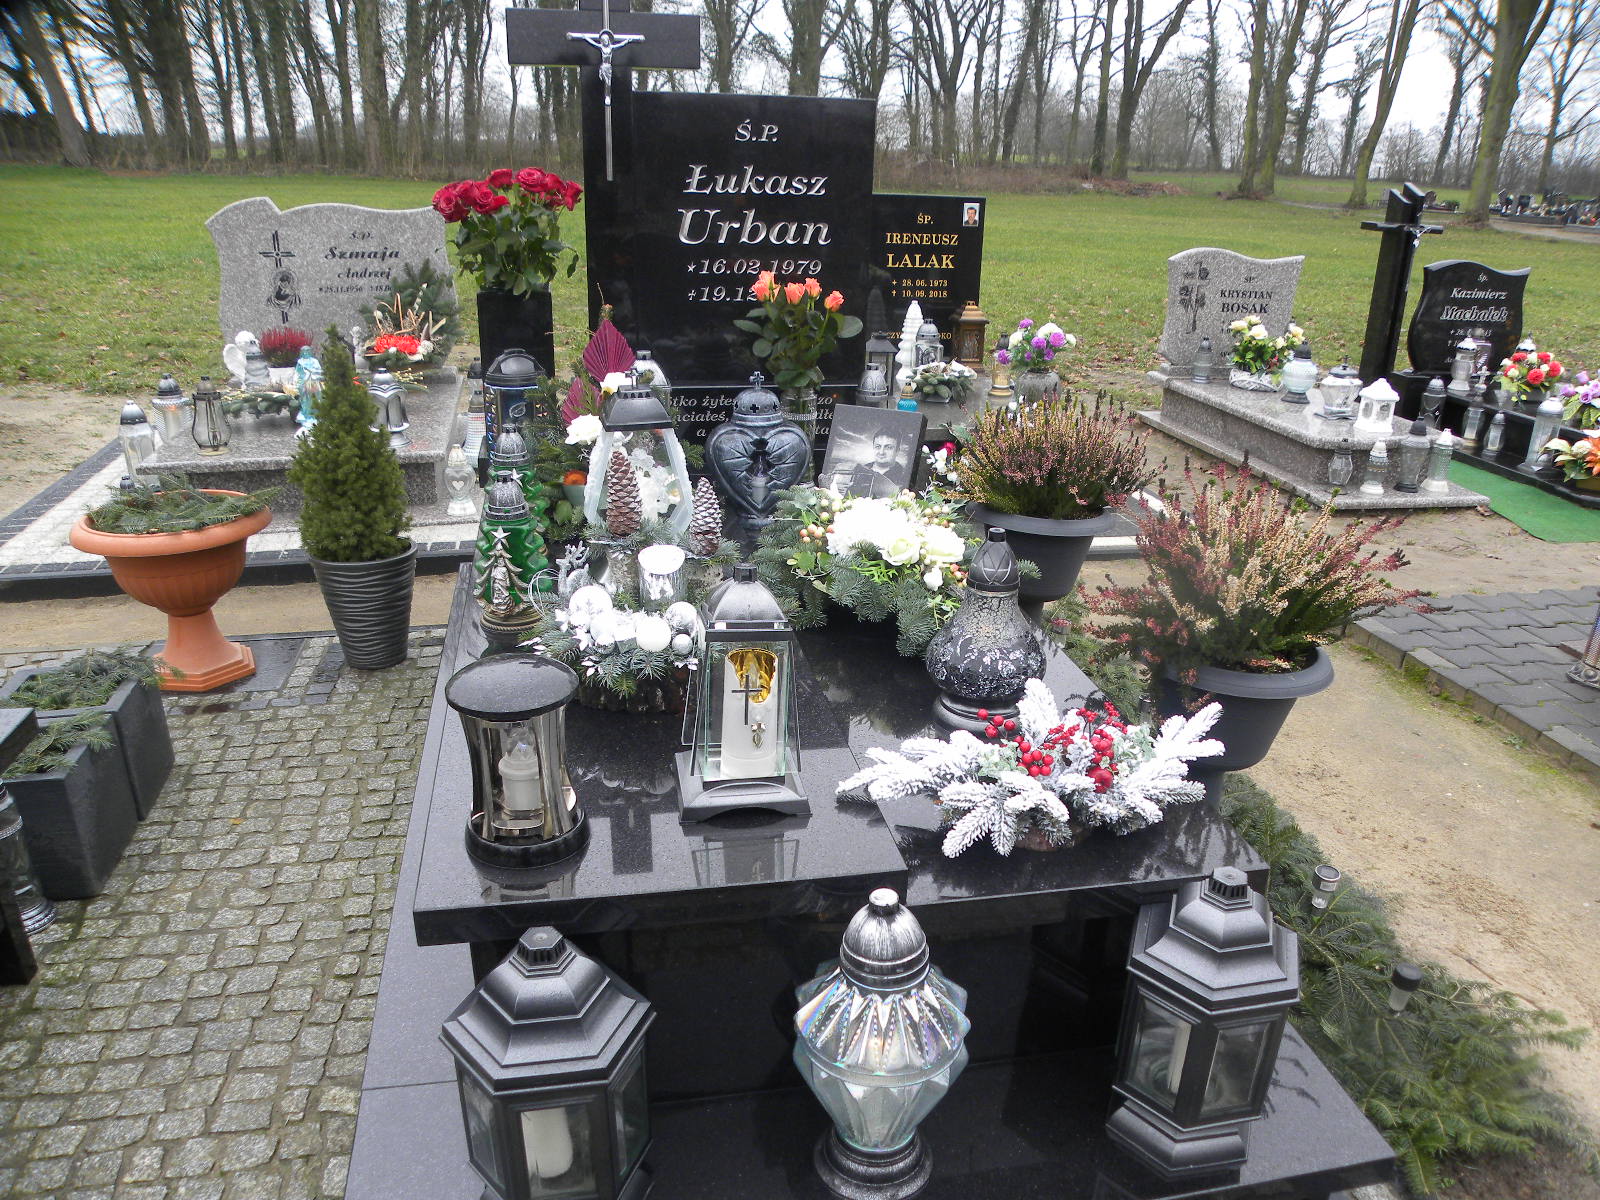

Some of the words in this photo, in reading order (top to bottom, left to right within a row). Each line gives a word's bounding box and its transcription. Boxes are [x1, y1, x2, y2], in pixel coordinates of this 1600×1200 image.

[735, 119, 779, 142] Ś.P.
[682, 163, 828, 196] Łukasz
[677, 208, 832, 246] Urban
[885, 232, 959, 246] IRENEUSZ
[324, 246, 400, 262] Szmaja
[886, 253, 955, 269] LALAK
[337, 267, 392, 280] Andrzej
[699, 258, 822, 275] 16.021979
[1220, 289, 1273, 300] KRYSTIAN
[1450, 287, 1508, 300] Kazimierz
[1221, 302, 1269, 314] BOSAK
